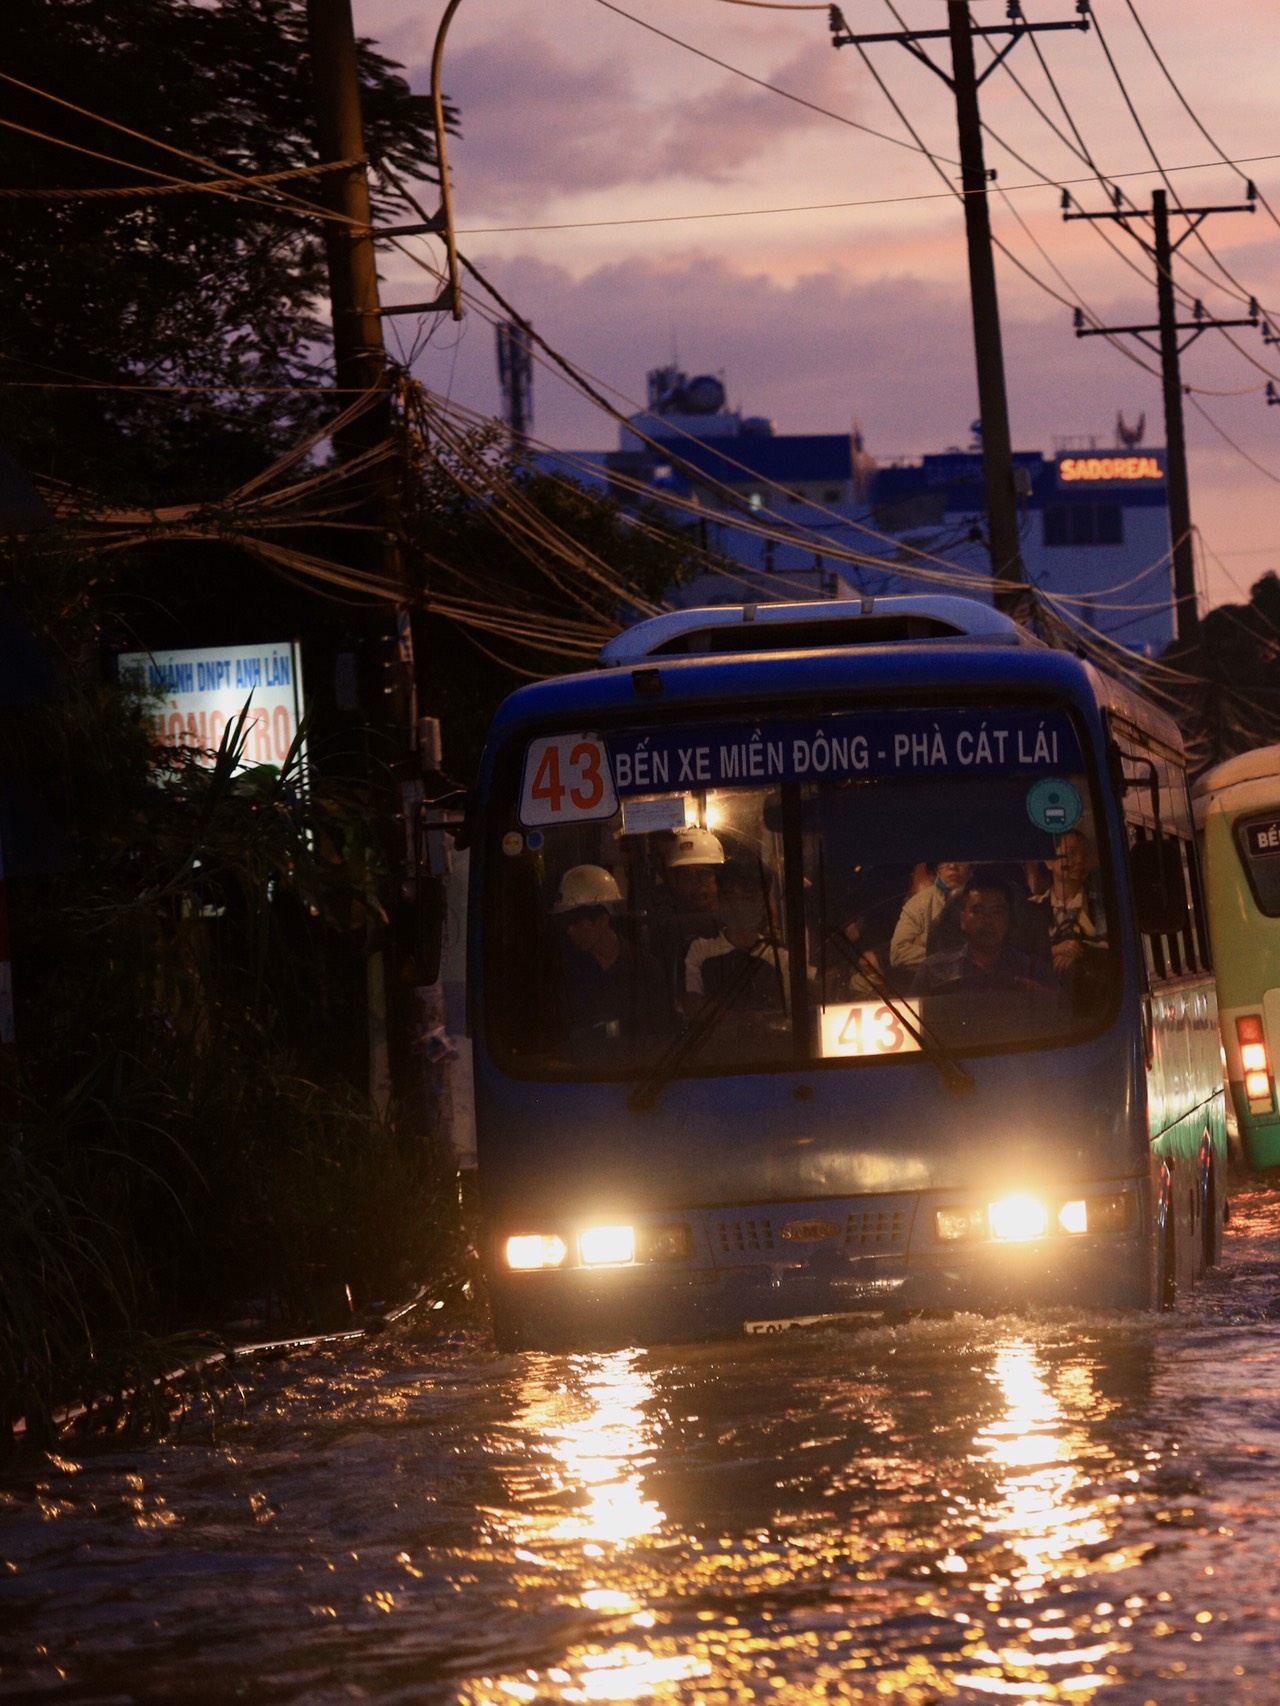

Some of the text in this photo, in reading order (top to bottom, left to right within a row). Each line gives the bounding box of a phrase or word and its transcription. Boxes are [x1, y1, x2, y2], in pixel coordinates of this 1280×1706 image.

[198, 660, 231, 691] DNPT
[236, 657, 260, 688] ANH
[531, 742, 604, 812] 43
[616, 737, 669, 787] BẾN
[678, 747, 711, 782] XE
[719, 729, 784, 779] MIỀN
[793, 729, 869, 773] ĐÔNG
[894, 723, 948, 767] PHÀ
[957, 721, 1009, 765] CÁT
[1018, 721, 1059, 764] LÁI
[838, 1005, 904, 1053] 43
